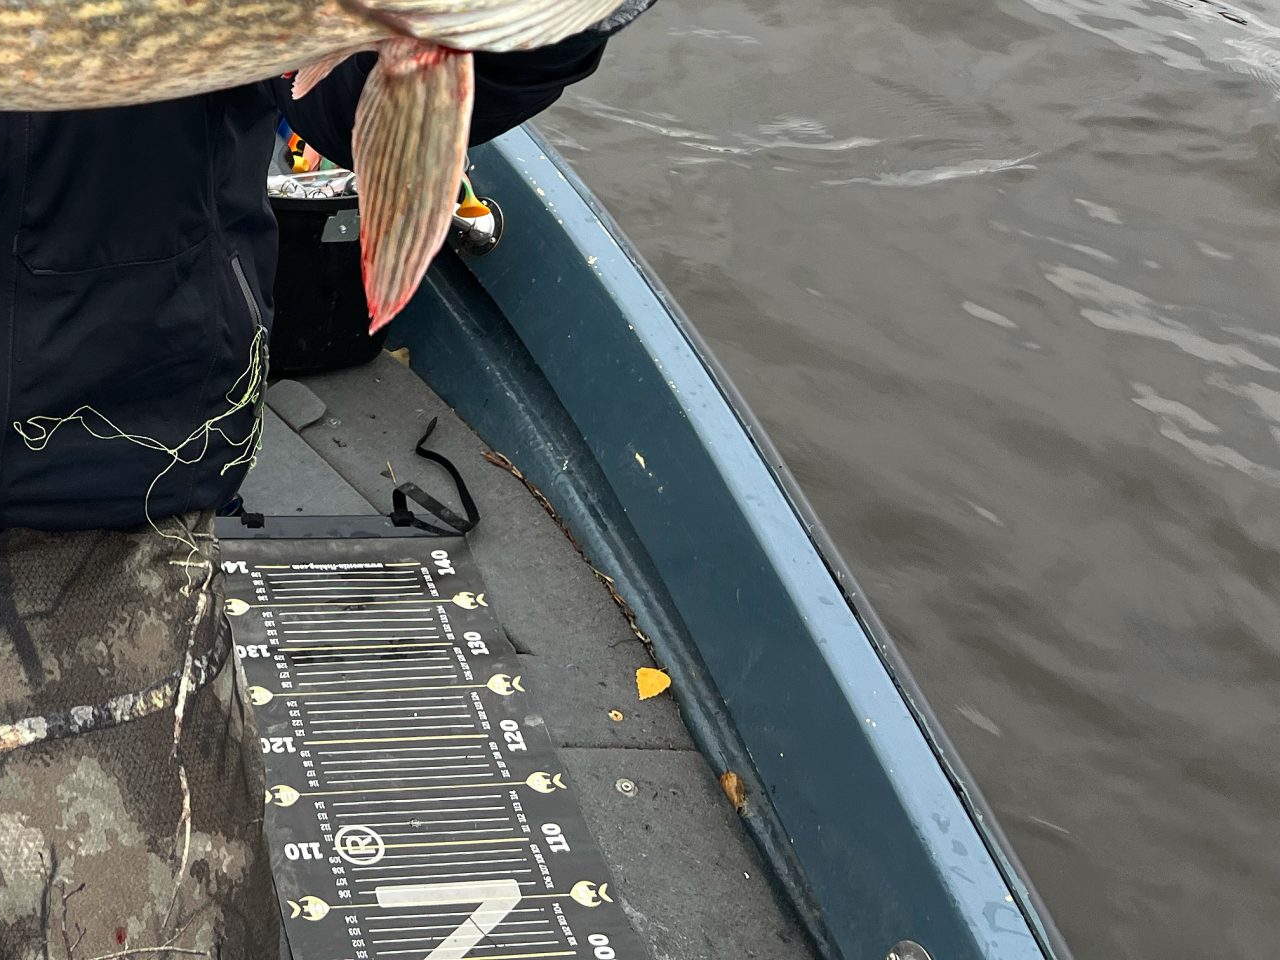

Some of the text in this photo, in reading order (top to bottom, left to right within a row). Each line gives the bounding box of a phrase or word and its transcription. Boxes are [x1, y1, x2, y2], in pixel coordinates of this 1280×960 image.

[431, 550, 456, 575] 140
[221, 561, 249, 574] 14
[464, 632, 490, 656] 130
[235, 644, 271, 658] 130
[500, 720, 527, 752] 120
[300, 750, 311, 758] 119
[303, 760, 314, 768] 118
[314, 802, 326, 810] 114
[317, 813, 328, 821] 113
[324, 834, 334, 842] 111
[541, 824, 571, 853] 110
[284, 842, 324, 860] 110
[329, 856, 342, 864] 109
[332, 866, 345, 875] 108
[336, 878, 348, 886] 107
[338, 890, 352, 899] 106
[345, 915, 358, 924] 104
[348, 928, 362, 936] 103
[352, 939, 366, 947] 102
[588, 934, 616, 960] 00
[356, 950, 369, 959] 101
